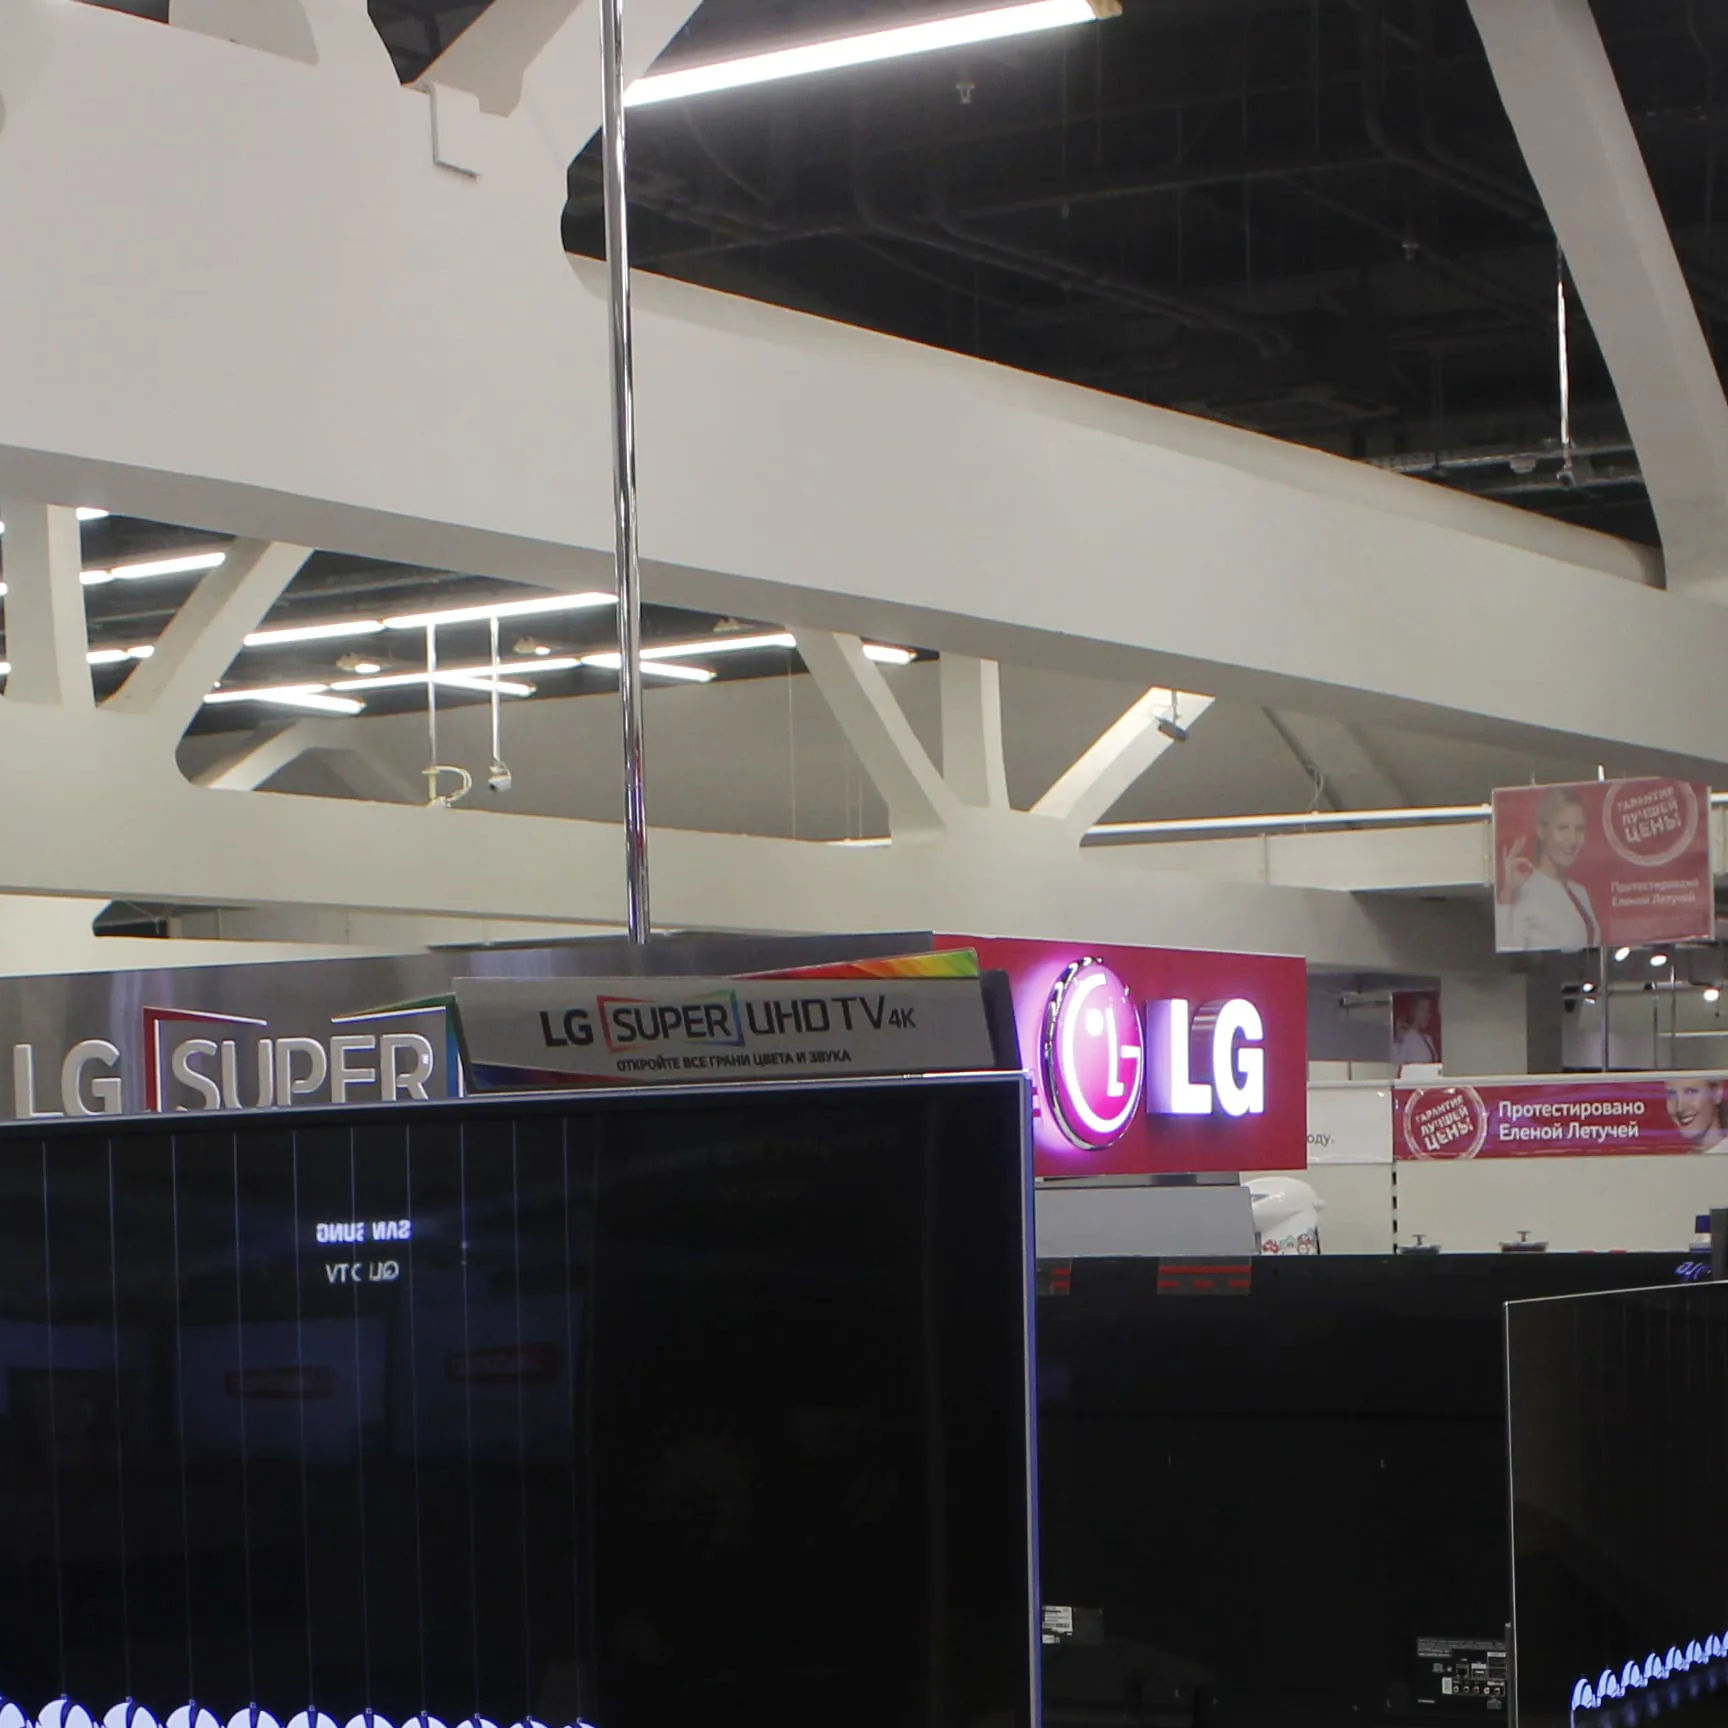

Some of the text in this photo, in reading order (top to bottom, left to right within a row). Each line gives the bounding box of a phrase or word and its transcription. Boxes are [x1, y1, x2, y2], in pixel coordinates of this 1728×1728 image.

[1624, 813, 1682, 843] ЦЕНЫ
[539, 995, 917, 1048] LG SUPER UHD TV 4K
[616, 1049, 852, 1072] ОТКРОЙТЕ ВСЕ ГРАНИ ЦВЕТА И ЗВУКА
[1165, 998, 1265, 1117] LG
[12, 1032, 435, 1118] LG SUPER
[1416, 1094, 1464, 1123] ГАРАНТИЯ
[1499, 1100, 1645, 1119] Протестировано
[1306, 1132, 1335, 1147] оду.
[1500, 1120, 1639, 1143] Еленой Летучей
